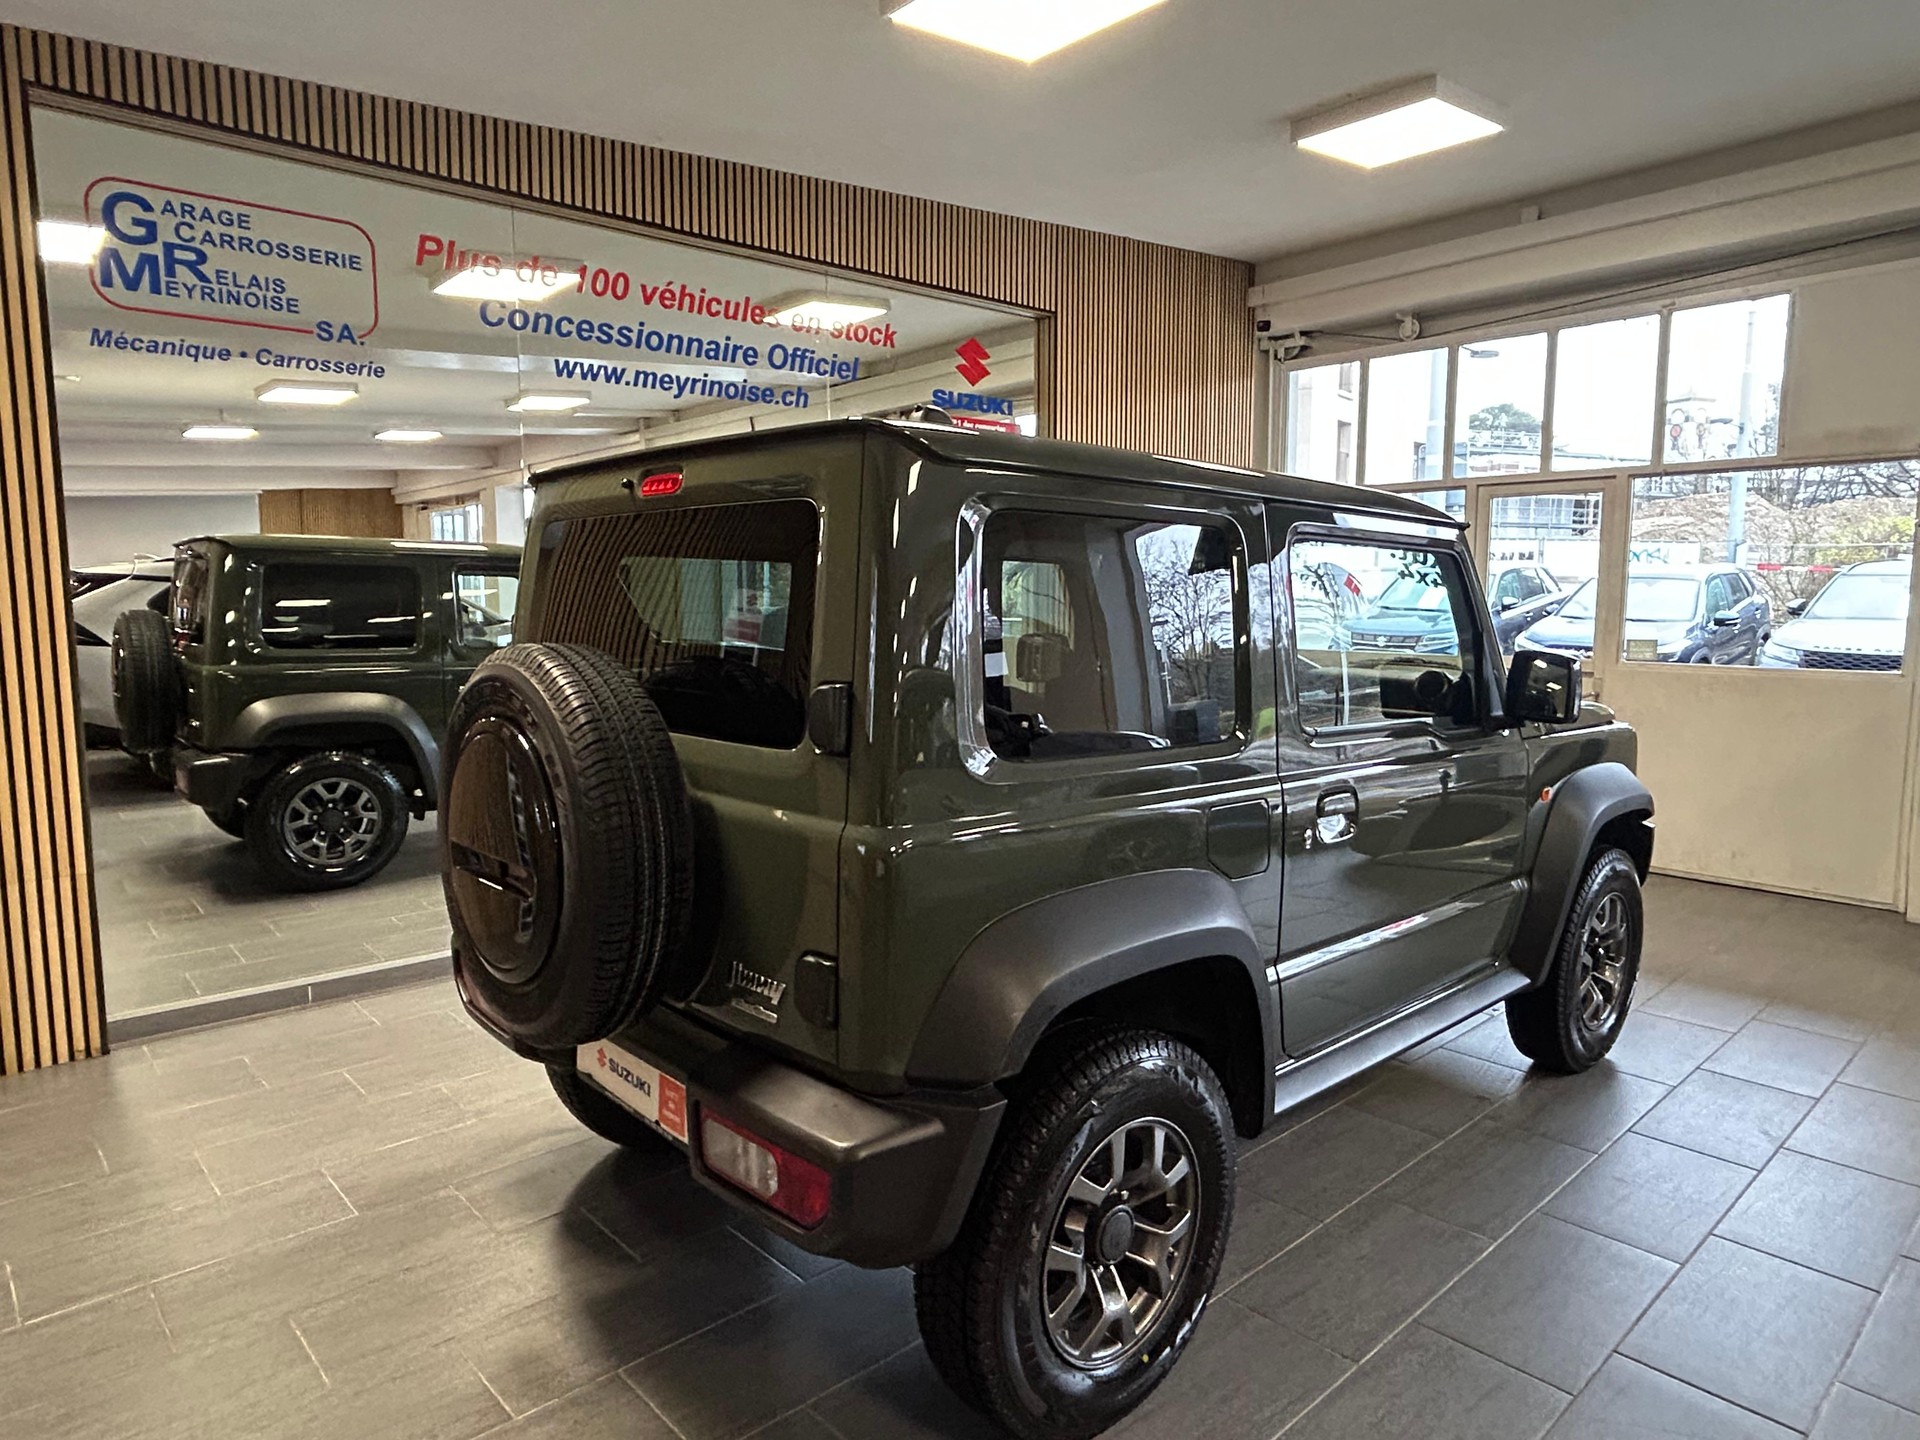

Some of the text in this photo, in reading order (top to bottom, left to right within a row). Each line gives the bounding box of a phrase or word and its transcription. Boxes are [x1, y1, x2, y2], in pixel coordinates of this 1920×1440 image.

[101, 191, 252, 246] GARAGE
[162, 241, 287, 295] RELAIS
[174, 221, 363, 271] CARROSSERIE
[100, 247, 301, 315] MEYRINOISE
[415, 234, 898, 349] Plus de 100 véhicules en stock
[89, 327, 386, 379] Mécanique Carrosserie
[479, 300, 860, 381] Concessionnaire Officiel
[554, 357, 809, 409] www.meyrinoise.ch
[931, 388, 1014, 416] SUZUKI
[608, 1057, 652, 1098] SUZUKI
